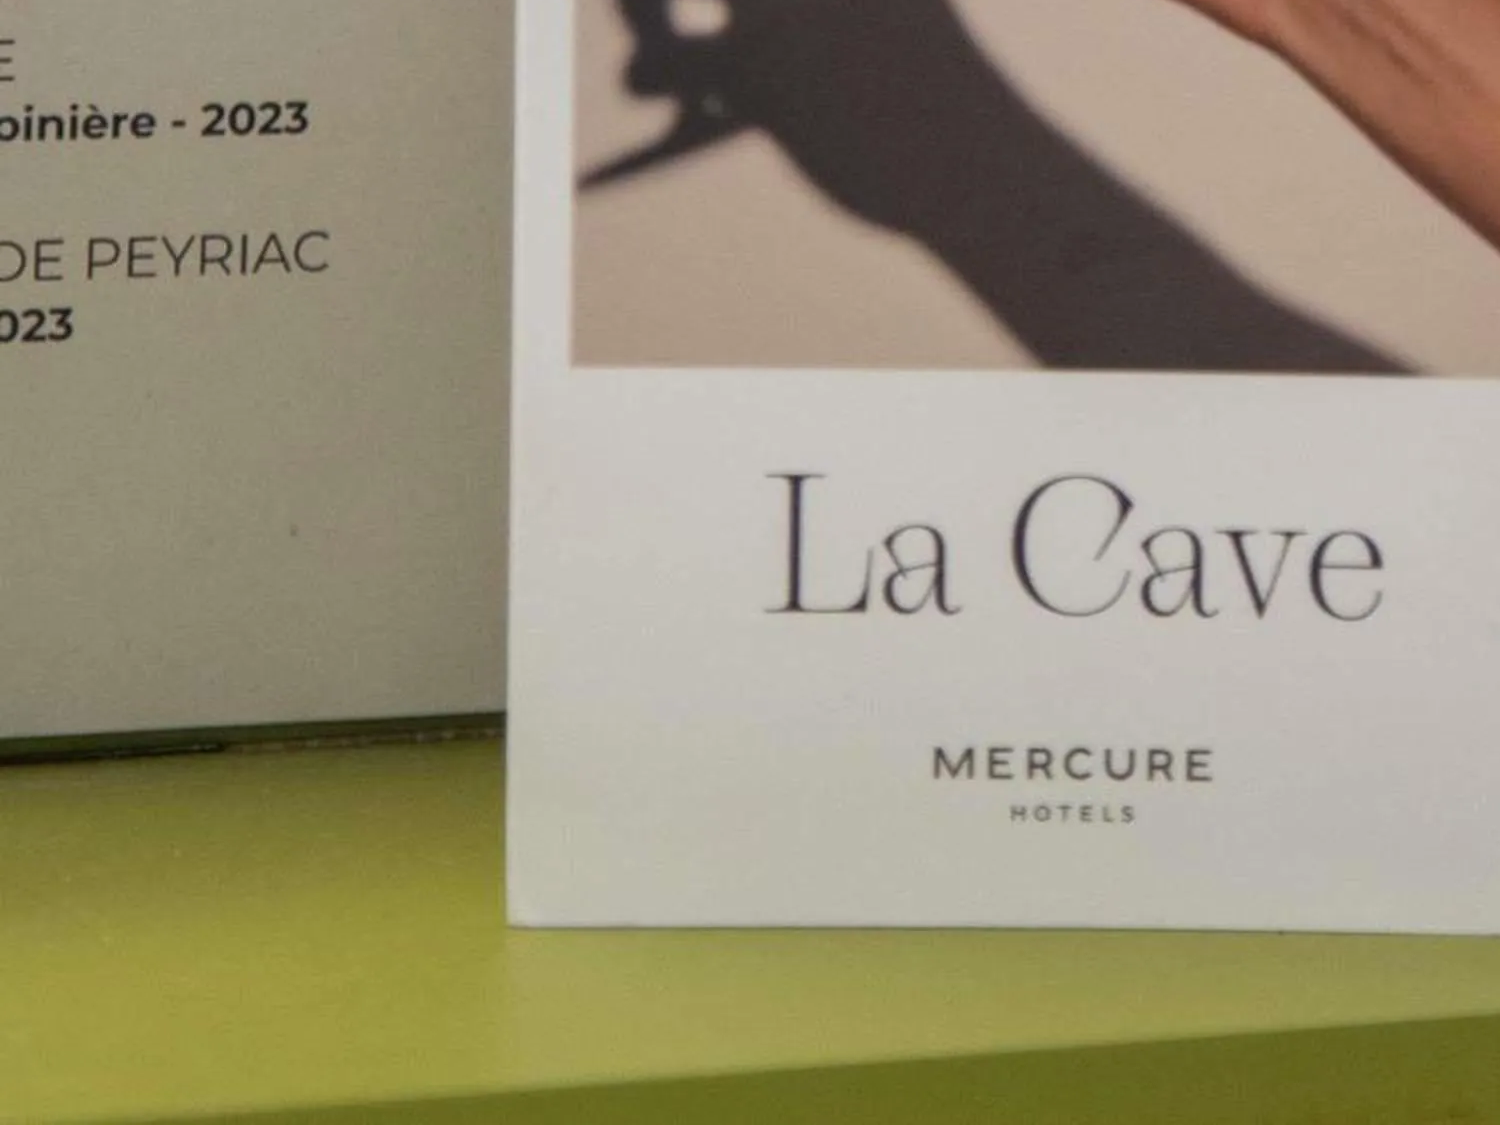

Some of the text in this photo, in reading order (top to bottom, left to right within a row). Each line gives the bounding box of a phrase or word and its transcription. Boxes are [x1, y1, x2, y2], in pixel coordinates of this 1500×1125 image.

[201, 101, 310, 136] 2023
[86, 231, 330, 279] PEYRIAC
[763, 472, 1384, 623] La Cave
[932, 747, 1214, 782] MERCURE
[1011, 806, 1136, 823] HOTELS
